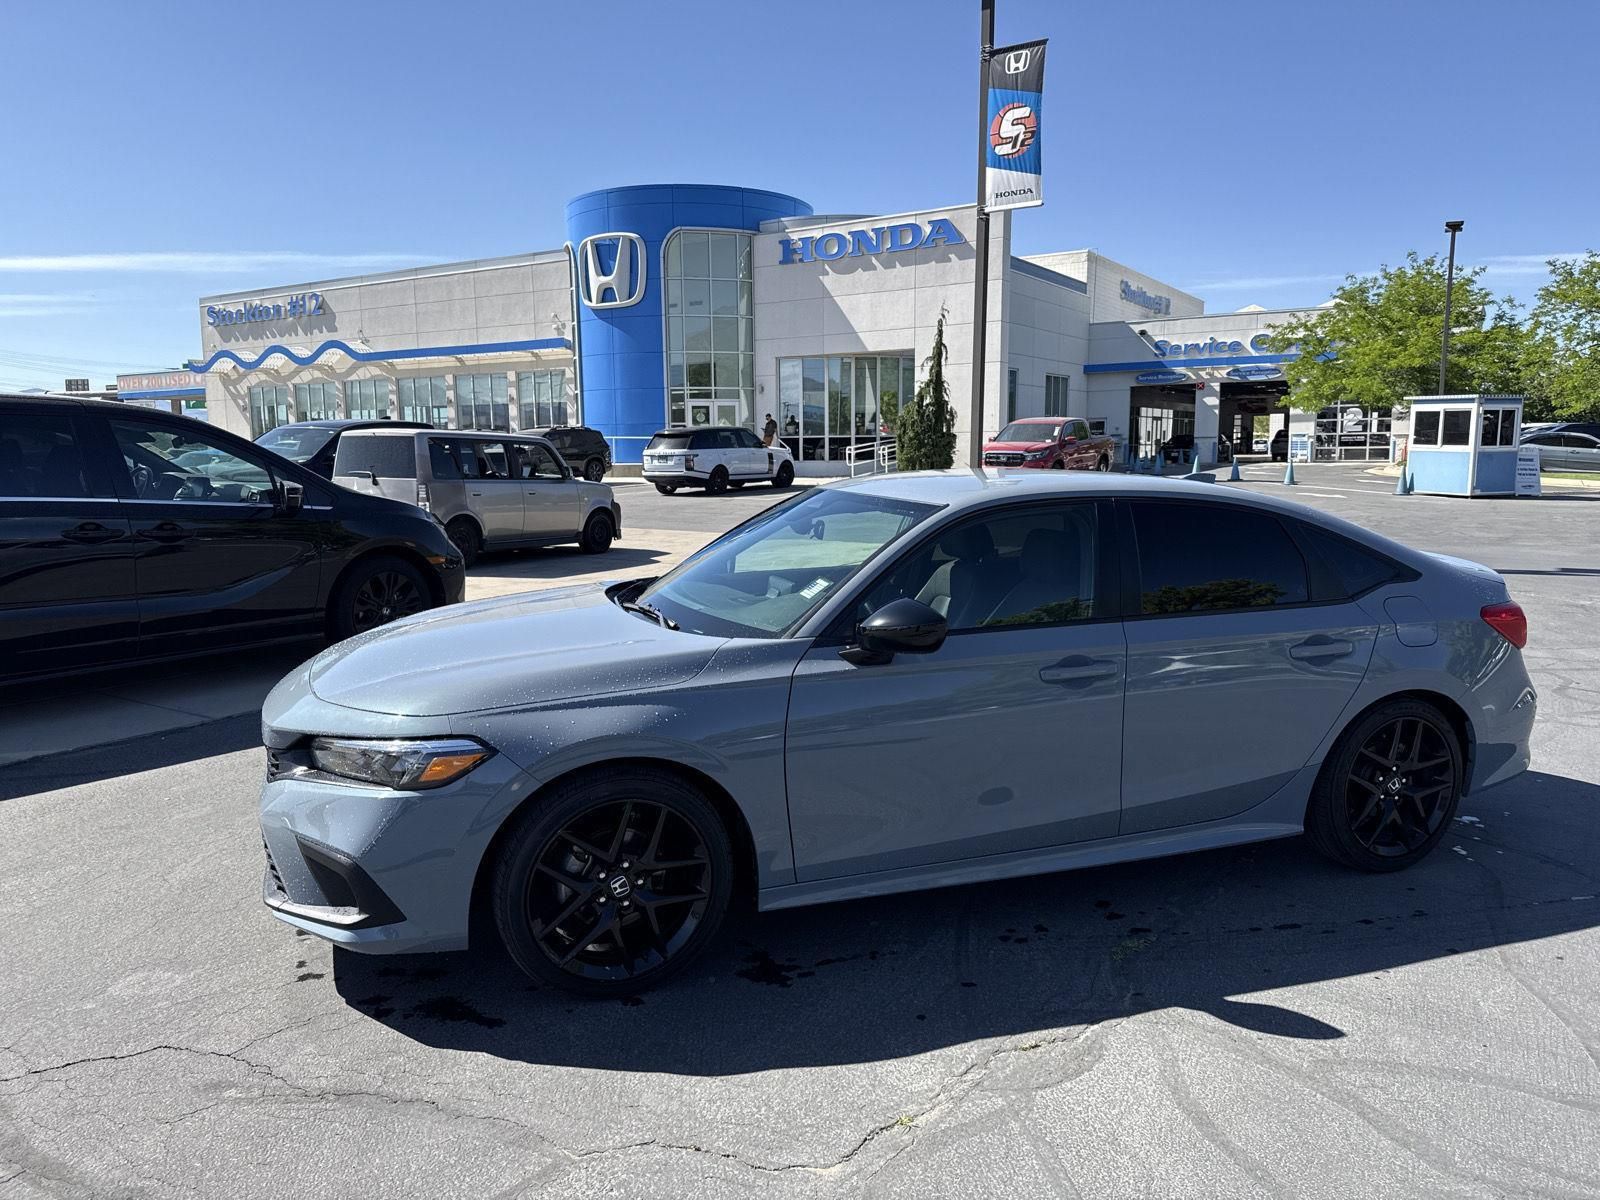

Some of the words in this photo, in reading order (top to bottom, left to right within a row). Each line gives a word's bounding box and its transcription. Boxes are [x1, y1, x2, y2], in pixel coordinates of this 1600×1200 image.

[995, 187, 1034, 199] HONDA
[778, 218, 966, 265] HONDA
[206, 302, 283, 326] Stockton
[288, 292, 322, 318] #12
[1154, 336, 1243, 357] Service
[119, 377, 144, 390] OVER
[146, 376, 162, 389] 200
[165, 374, 191, 387] USED
